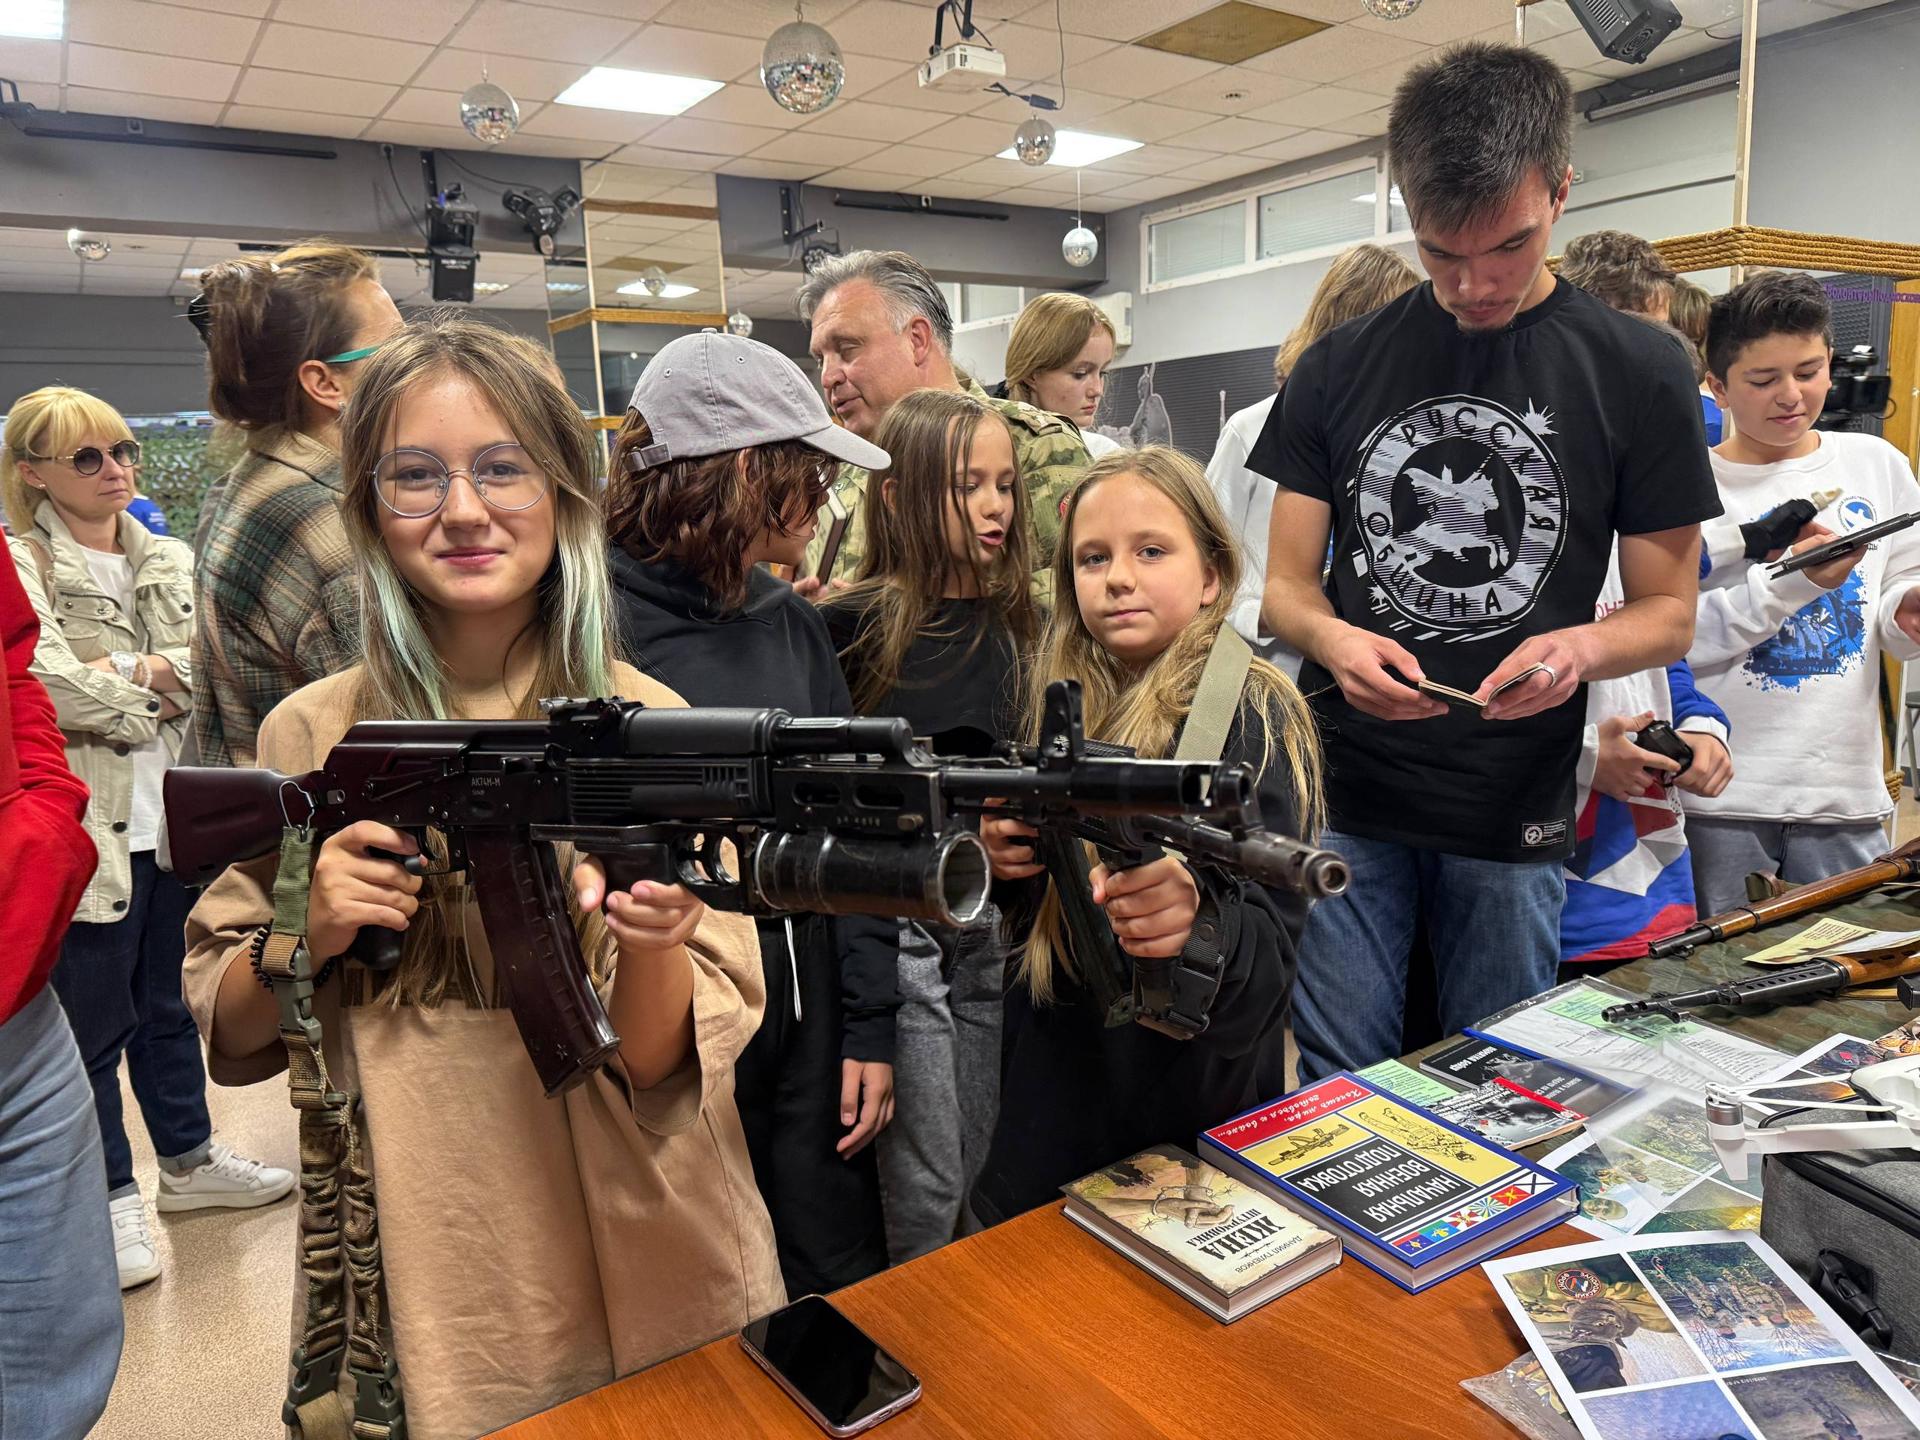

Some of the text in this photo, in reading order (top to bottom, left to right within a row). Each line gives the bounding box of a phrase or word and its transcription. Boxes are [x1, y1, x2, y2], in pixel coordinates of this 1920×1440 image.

[1400, 406, 1556, 531] РУССКАЯ
[1366, 511, 1502, 617] ОБЩИНА
[1297, 1145, 1402, 1192] ПОДГОТОВКА
[1351, 1159, 1432, 1193] ВОЕННАЯ
[1363, 1177, 1456, 1222] НАЧАЛЬНАЯ
[1185, 1208, 1262, 1248] ШТУРМОВИКА
[1198, 1216, 1286, 1261] ЖЕНА
